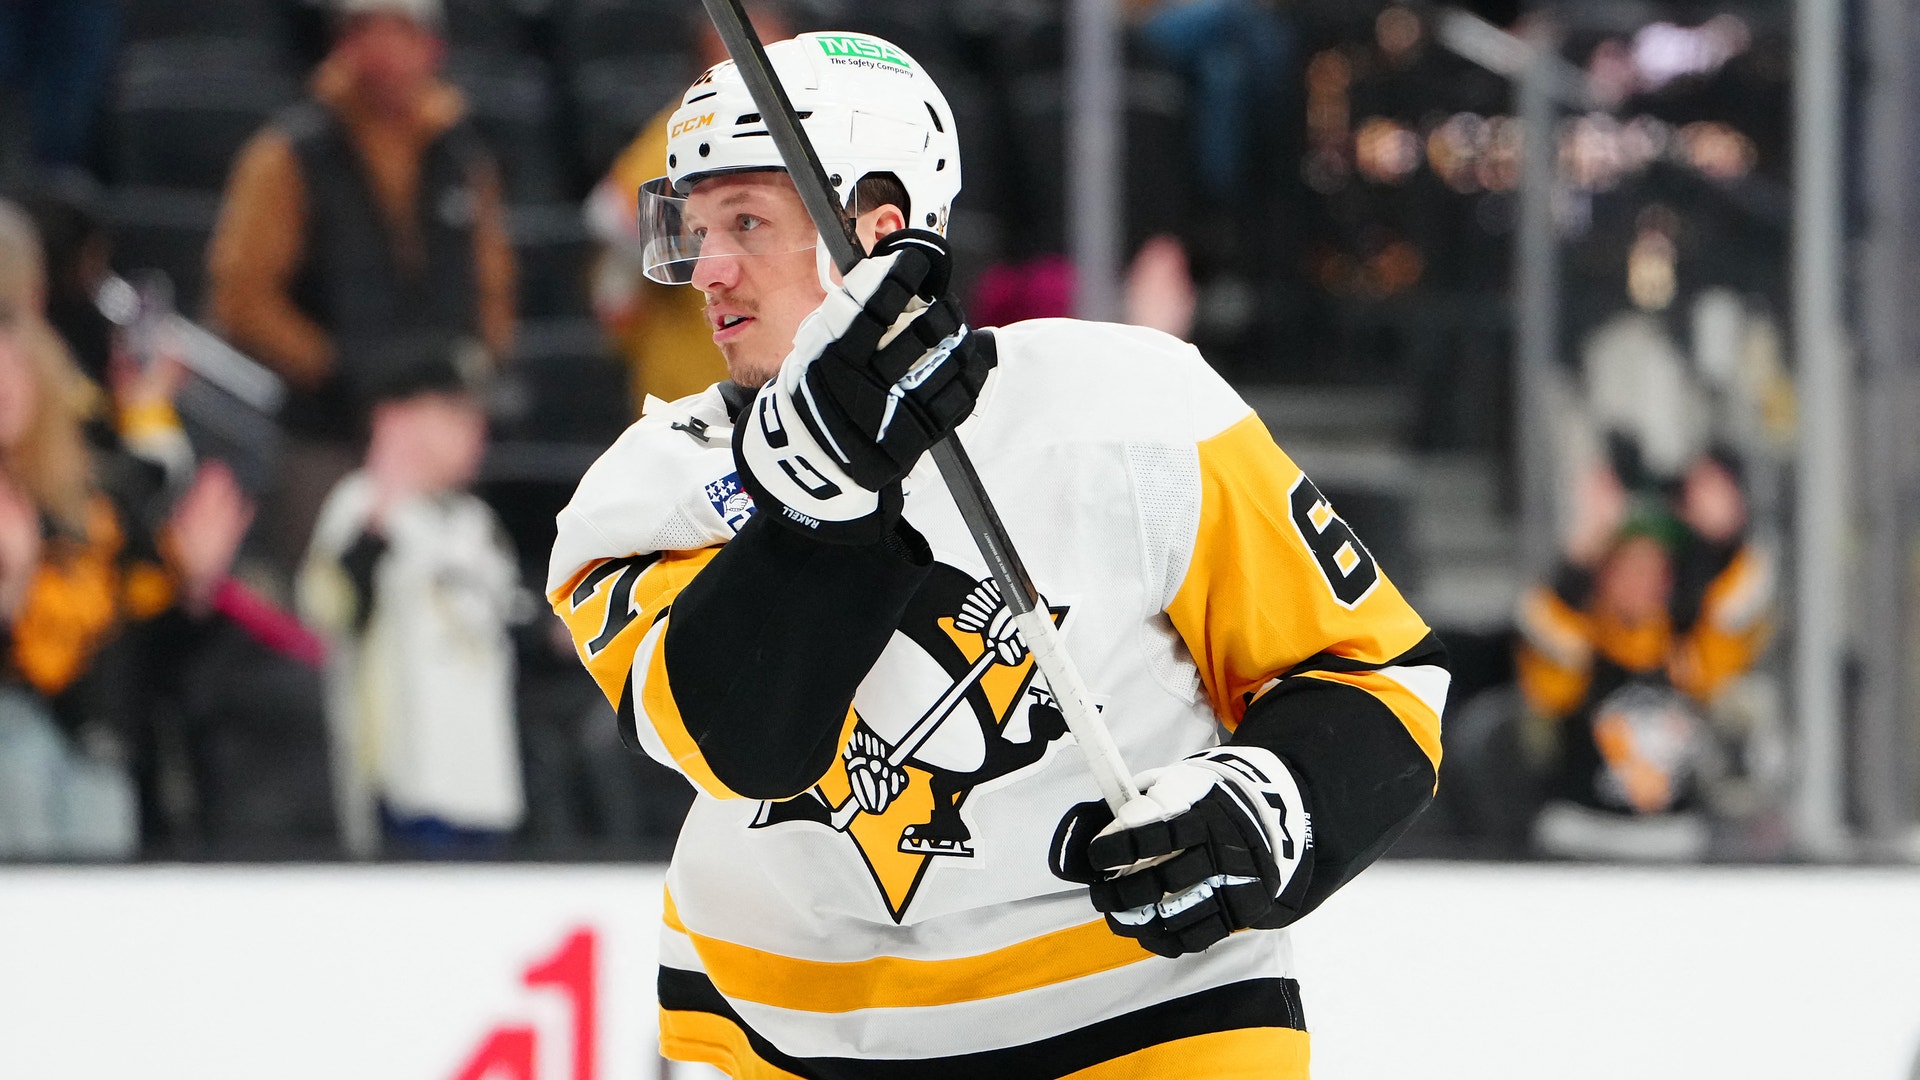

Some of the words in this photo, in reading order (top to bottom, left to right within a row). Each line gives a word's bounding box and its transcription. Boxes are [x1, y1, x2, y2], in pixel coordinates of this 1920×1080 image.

[817, 37, 909, 66] MSA
[848, 58, 875, 69] Safety
[876, 62, 914, 78] Company
[672, 113, 715, 138] CCM
[759, 374, 844, 501] CC
[782, 505, 820, 530] RAKELL
[570, 551, 662, 662] 7
[1303, 812, 1314, 850] RAKELL
